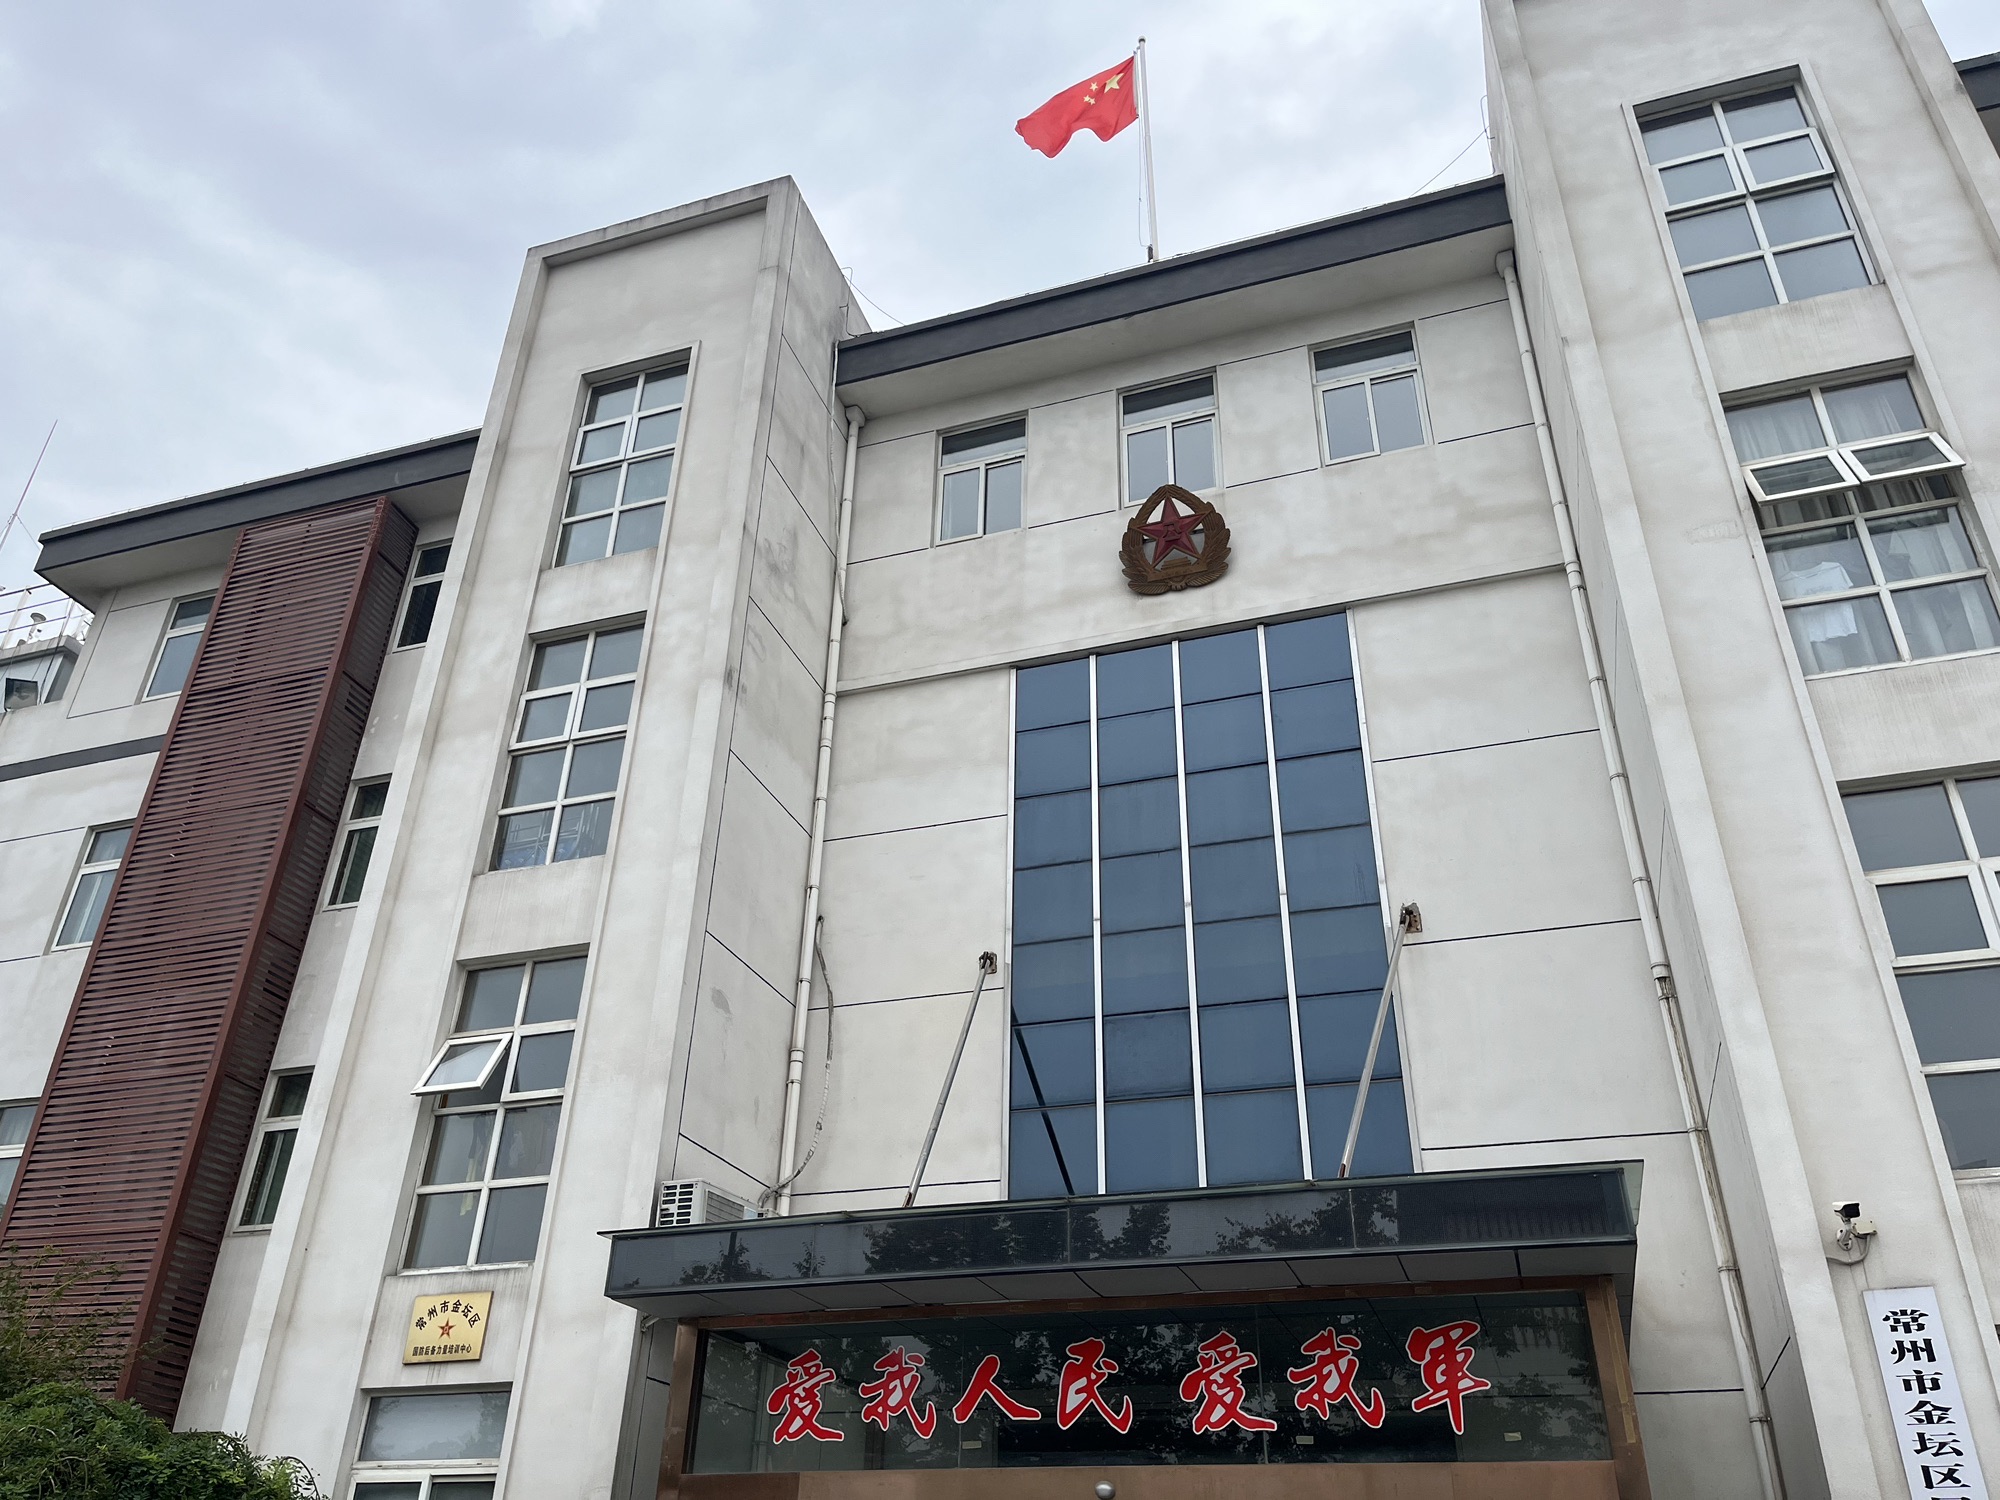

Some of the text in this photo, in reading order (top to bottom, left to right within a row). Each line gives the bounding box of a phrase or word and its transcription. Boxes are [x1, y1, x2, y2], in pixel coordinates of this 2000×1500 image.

[415, 1299, 481, 1331] 常州市金坛区
[412, 1343, 472, 1356] 国防后备力量培训中心
[1882, 1308, 1972, 1500] 常州市金坛区
